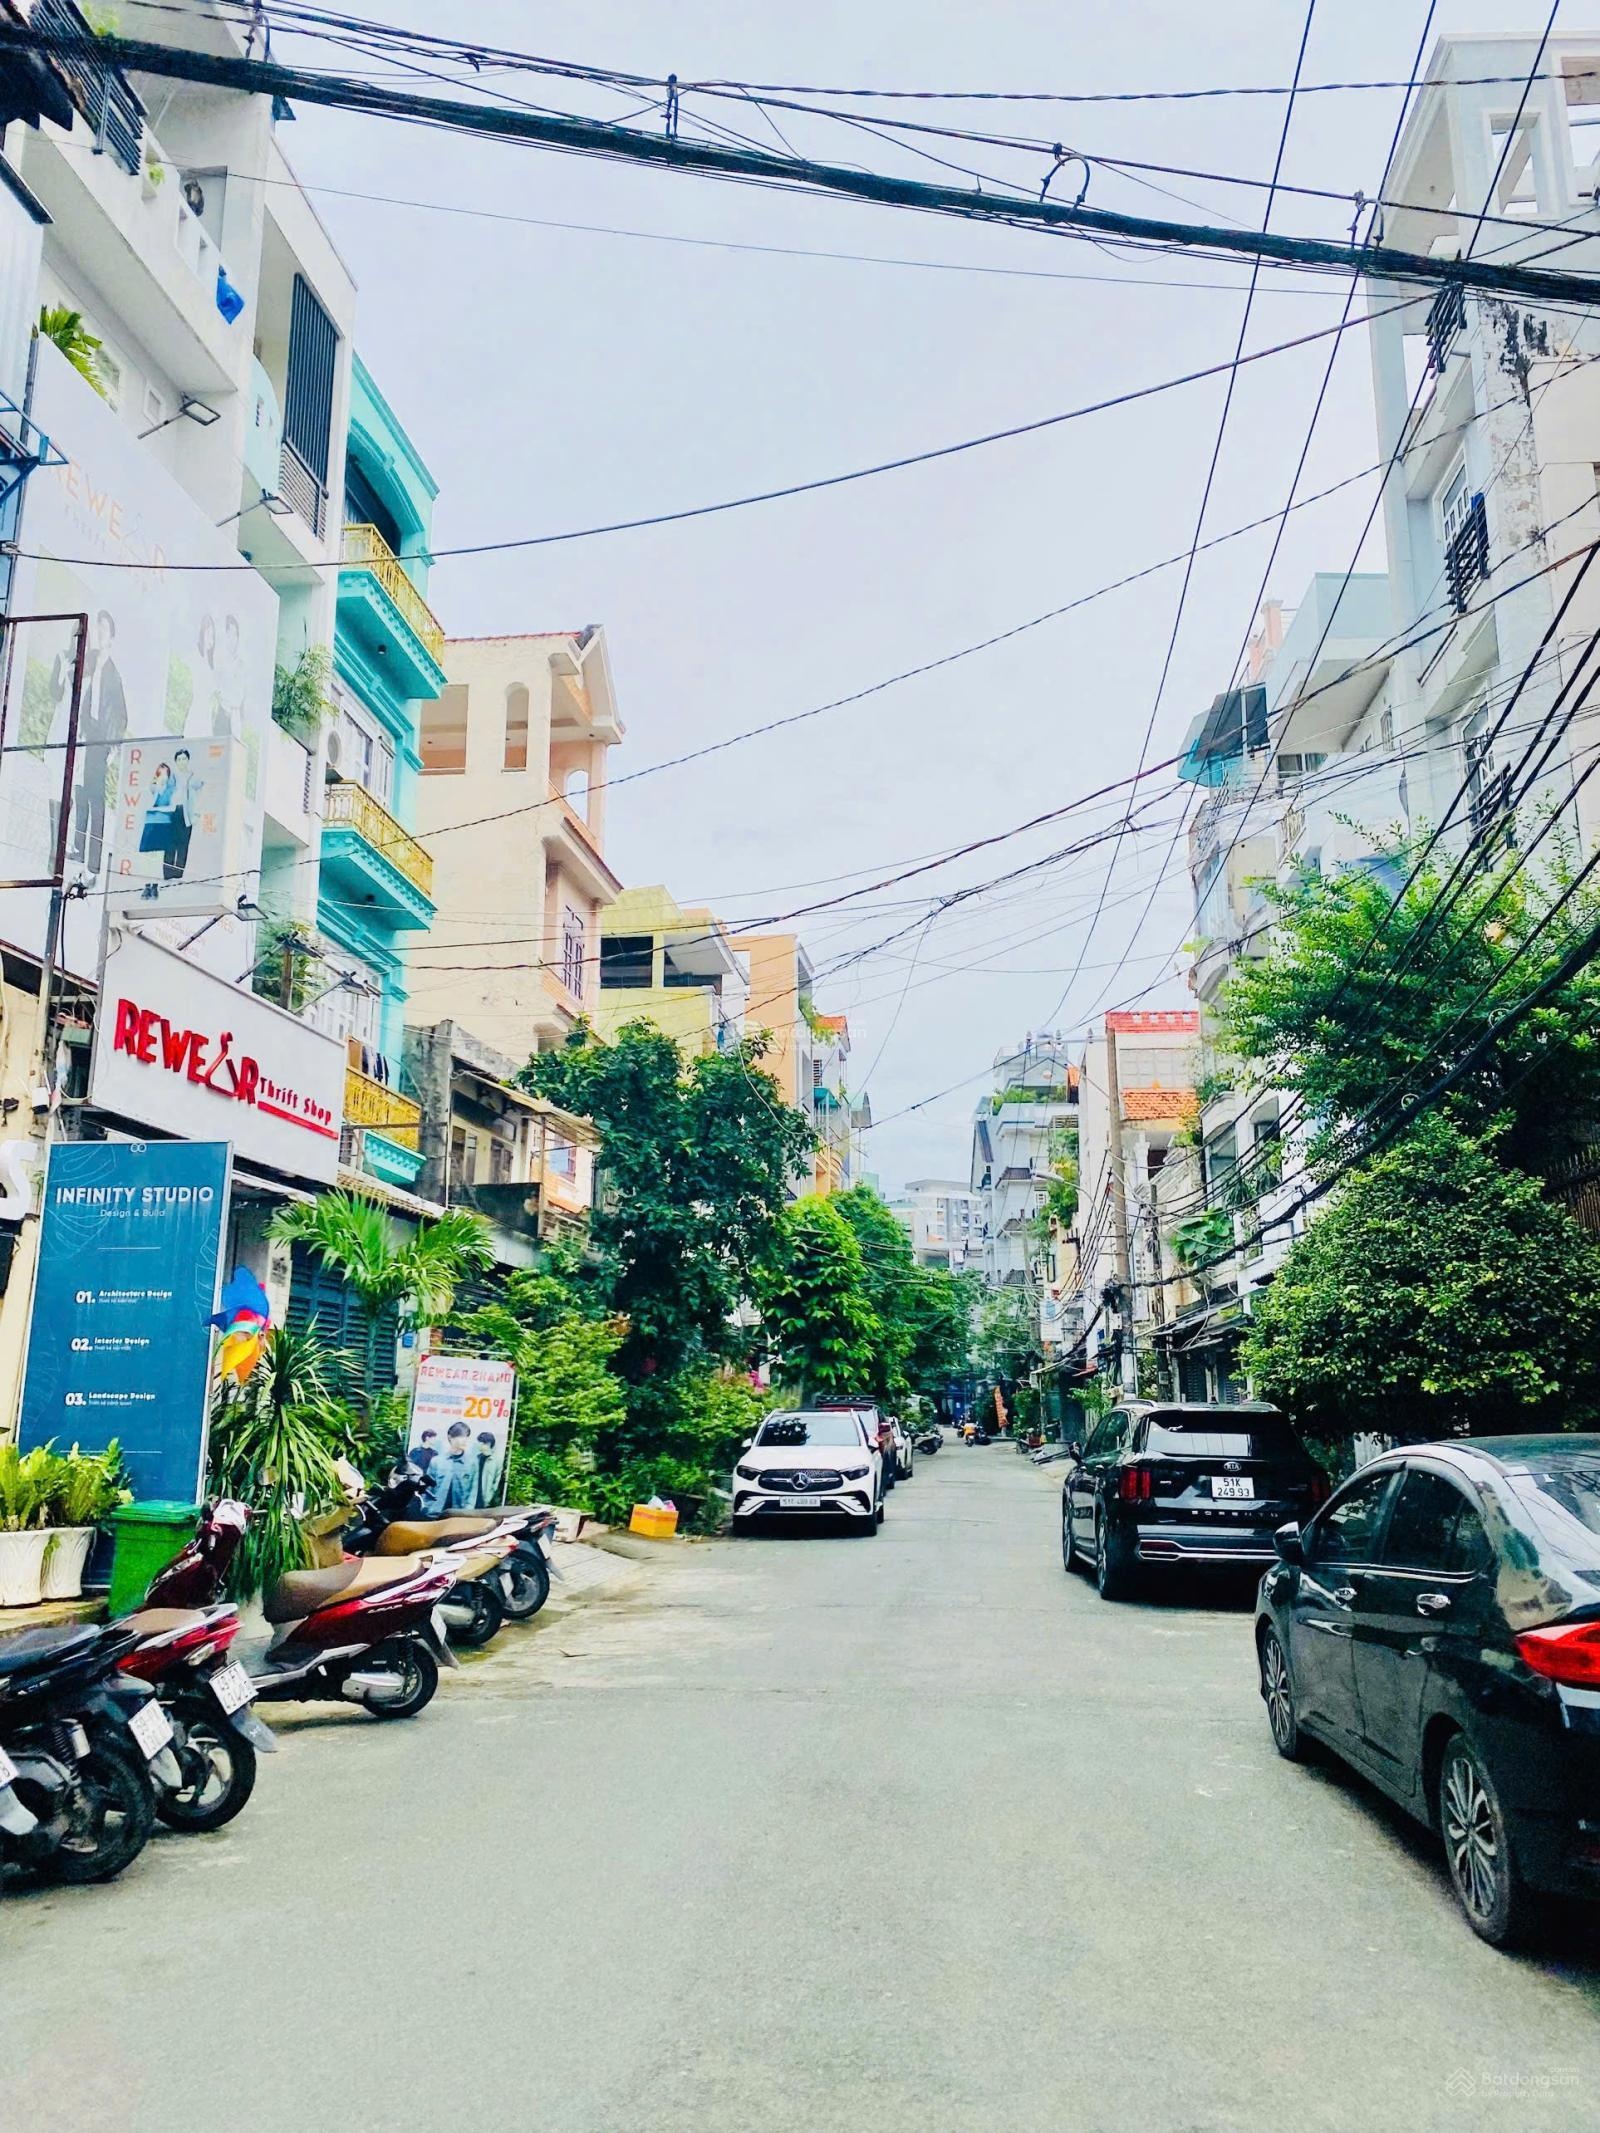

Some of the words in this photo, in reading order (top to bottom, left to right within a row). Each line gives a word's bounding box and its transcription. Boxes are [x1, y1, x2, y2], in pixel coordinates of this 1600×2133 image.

[114, 998, 259, 1104] REWEAR
[259, 1077, 299, 1108] Thrift
[303, 1098, 332, 1125] Shop
[56, 1187, 136, 1204] INFINITY
[142, 1186, 214, 1203] STUDIO
[100, 1209, 131, 1219] Design
[133, 1209, 140, 1217] &
[143, 1208, 166, 1217] Build
[75, 1290, 96, 1304] 01.
[147, 1290, 173, 1299] Design
[71, 1338, 93, 1351] 02.
[125, 1337, 150, 1347] Design
[65, 1392, 87, 1406] 03.
[130, 1392, 156, 1401] Design
[463, 1396, 510, 1419] 20%
[1223, 1478, 1241, 1487] 51K
[1217, 1488, 1250, 1497] 249.93
